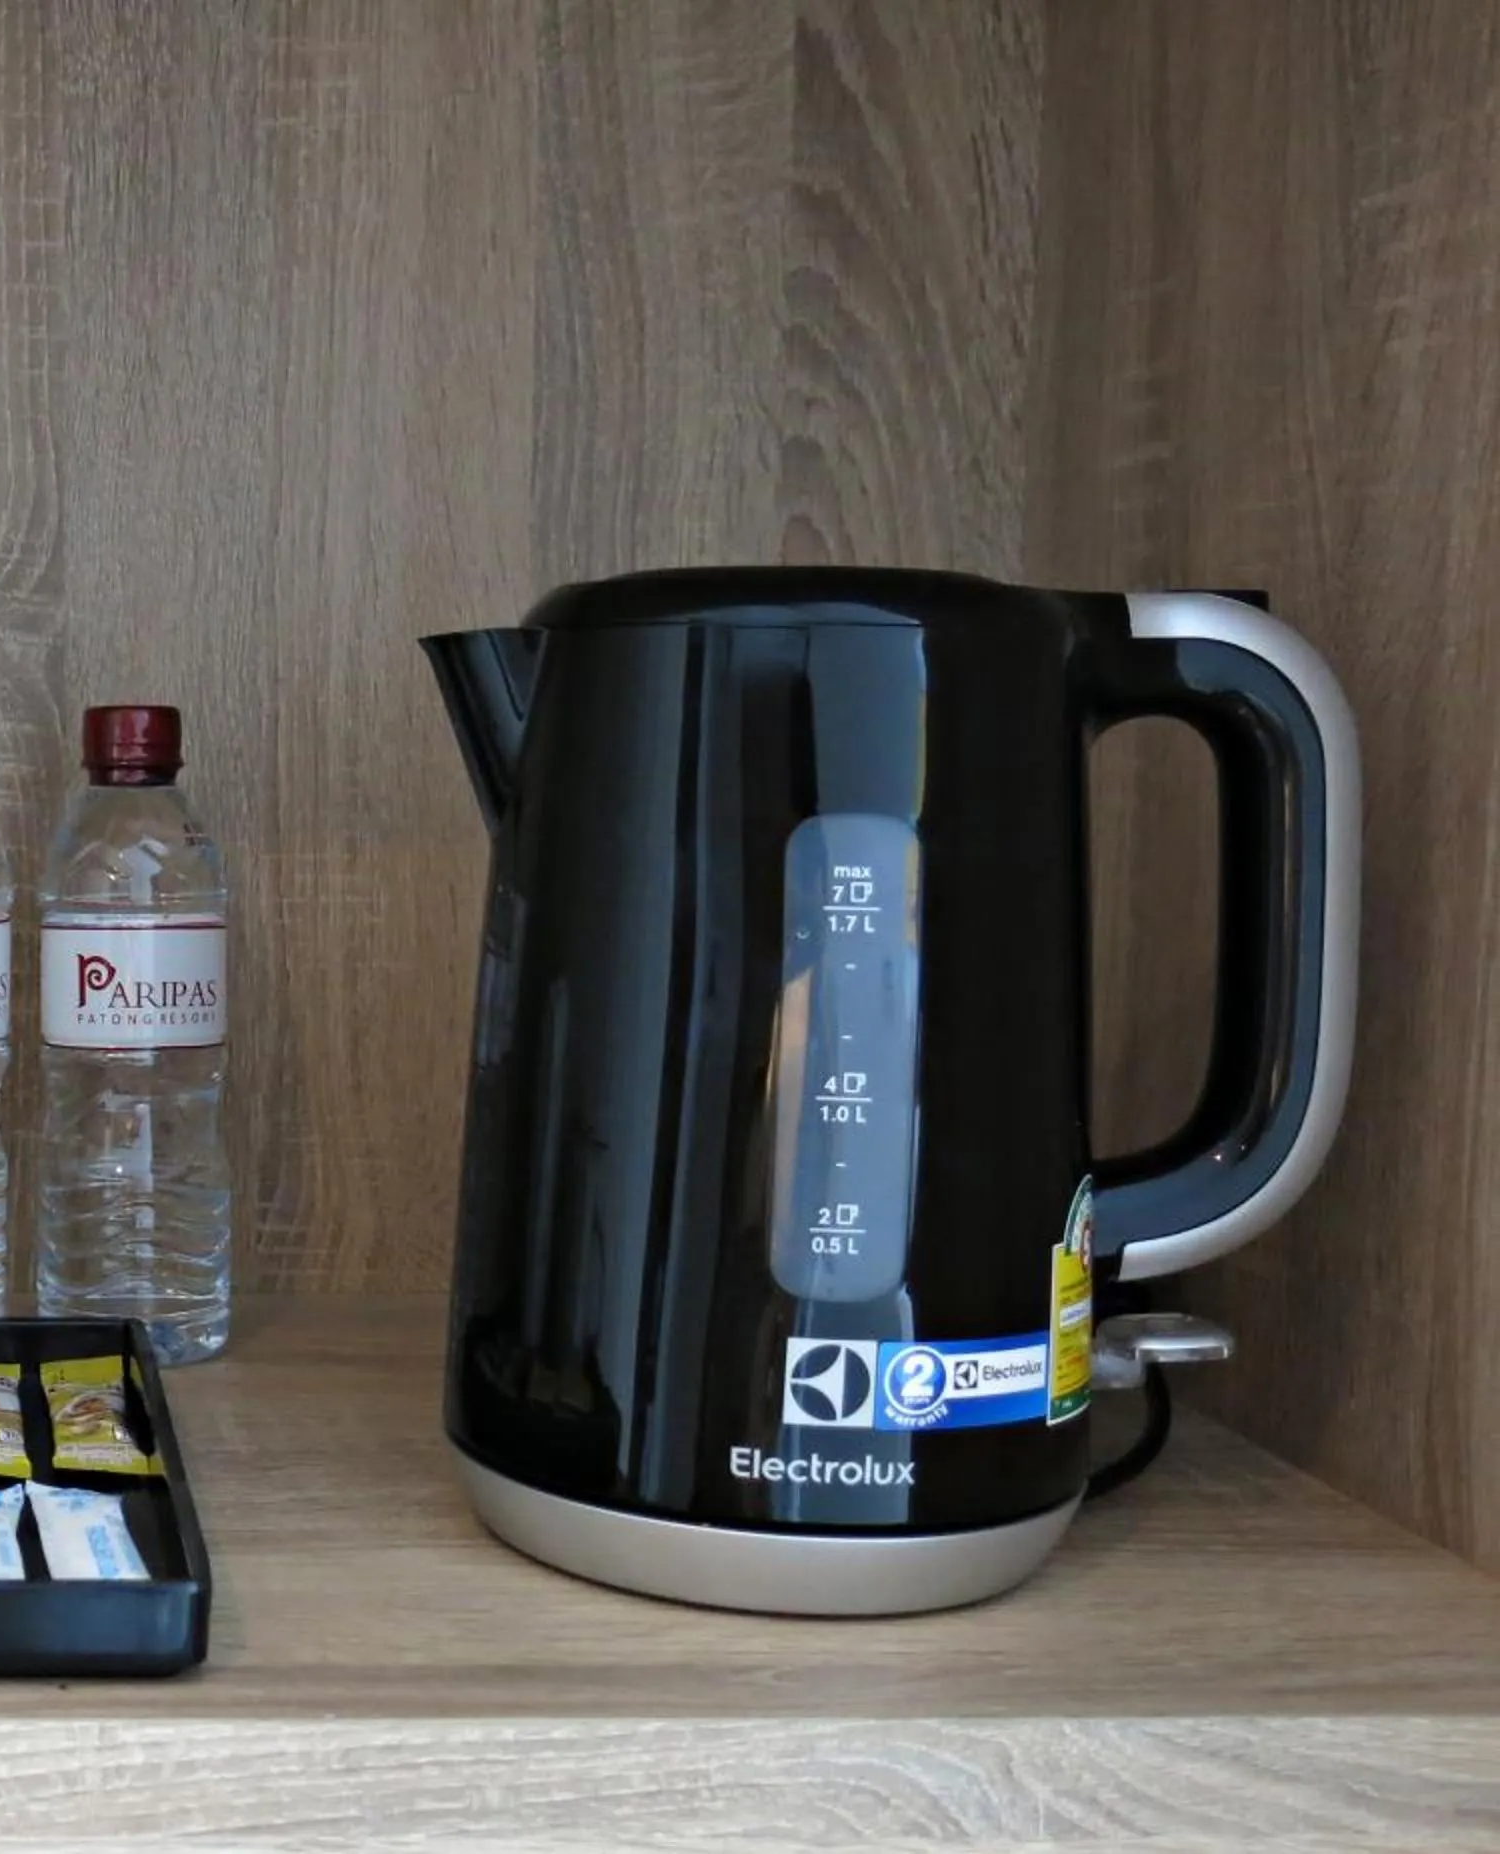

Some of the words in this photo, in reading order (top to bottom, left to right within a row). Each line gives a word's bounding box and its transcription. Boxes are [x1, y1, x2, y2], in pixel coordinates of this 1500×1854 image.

[833, 866, 872, 878] max
[832, 885, 845, 903] 7
[828, 914, 857, 932] 1.7
[863, 914, 876, 933] L
[77, 953, 217, 1009] PARIPAS
[77, 1012, 152, 1025] PATONG
[824, 1075, 837, 1093] 4
[819, 1105, 849, 1122] 1.0
[855, 1105, 867, 1123] L
[818, 1207, 831, 1225] 2
[811, 1237, 841, 1253] 0.5
[848, 1237, 859, 1254] L
[900, 1353, 936, 1397] 2
[982, 1359, 1043, 1381] Electrolux
[729, 1446, 915, 1486] Electrolux
